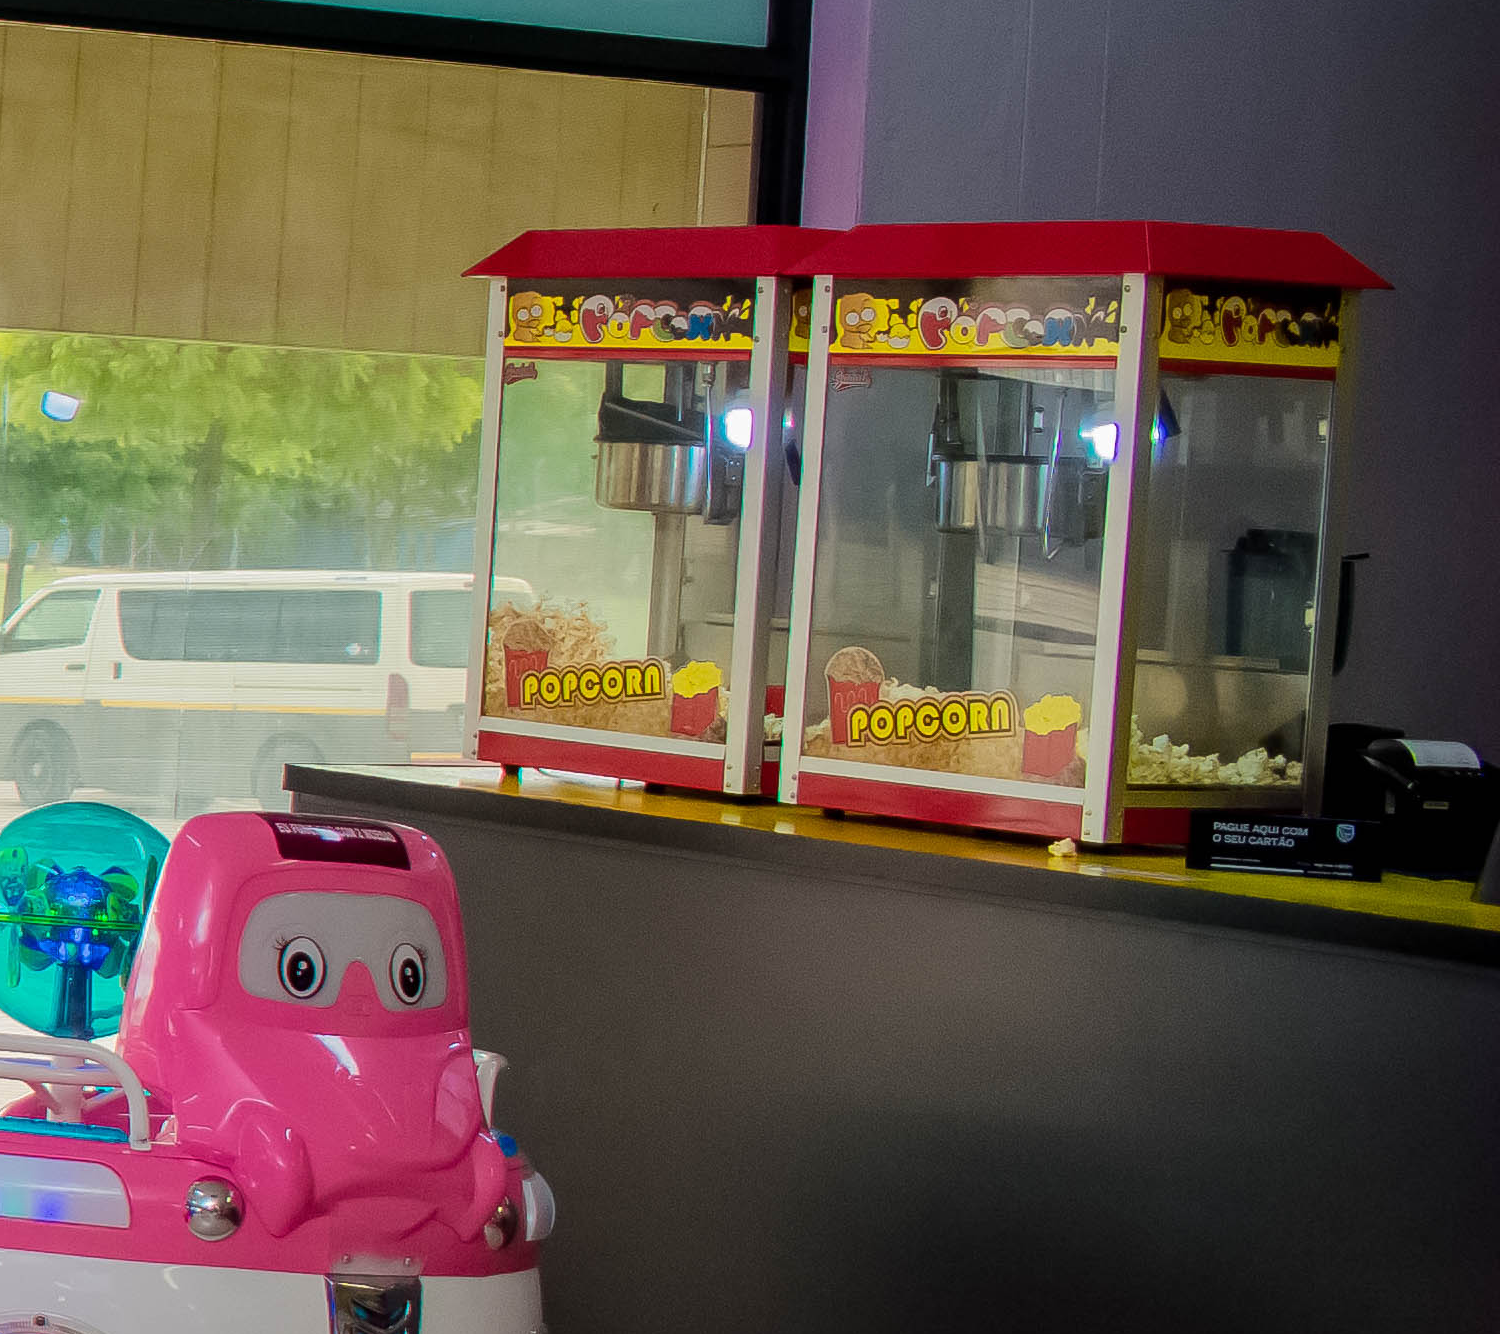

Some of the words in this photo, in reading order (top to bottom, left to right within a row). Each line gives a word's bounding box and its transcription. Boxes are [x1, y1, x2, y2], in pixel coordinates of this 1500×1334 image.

[522, 662, 665, 708] POPCORN
[849, 699, 1013, 744] POPCORN
[1212, 833, 1221, 843] O
[1224, 834, 1246, 844] SEU
[1248, 835, 1295, 848] CARTÃO
[1213, 821, 1250, 833] PAGUE
[1252, 824, 1280, 836] AQUI
[1282, 826, 1309, 836] COM
